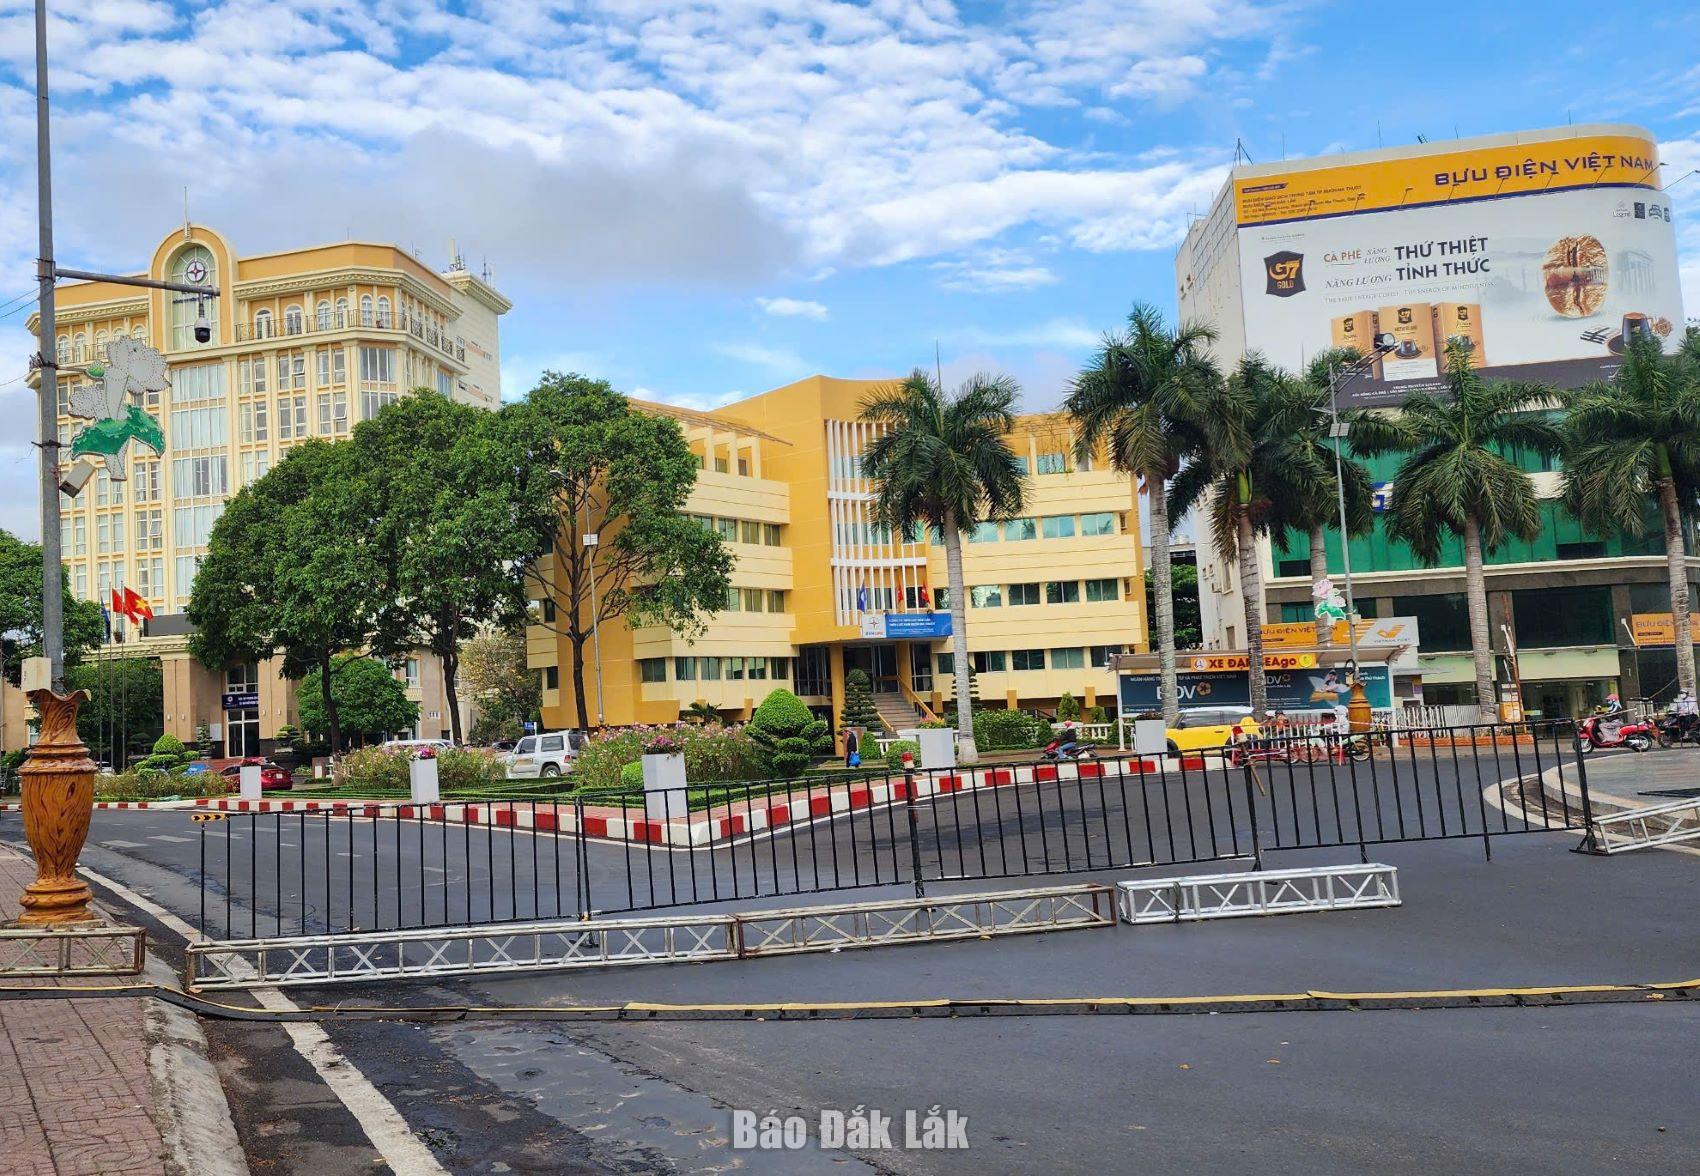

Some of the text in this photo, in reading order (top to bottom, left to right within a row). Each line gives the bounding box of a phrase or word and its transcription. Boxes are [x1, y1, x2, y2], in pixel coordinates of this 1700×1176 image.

[1434, 151, 1654, 186] BƯU ĐIỆN VIỆT NAM
[1341, 248, 1362, 261] PHÊ
[1394, 235, 1488, 260] THỨ THIỆT
[1396, 257, 1491, 281] TỈNH THỨC
[1277, 279, 1294, 289] GOLD
[1355, 274, 1393, 287] LƯỢNG
[1208, 658, 1226, 669] XE
[1265, 656, 1297, 671] EAgo
